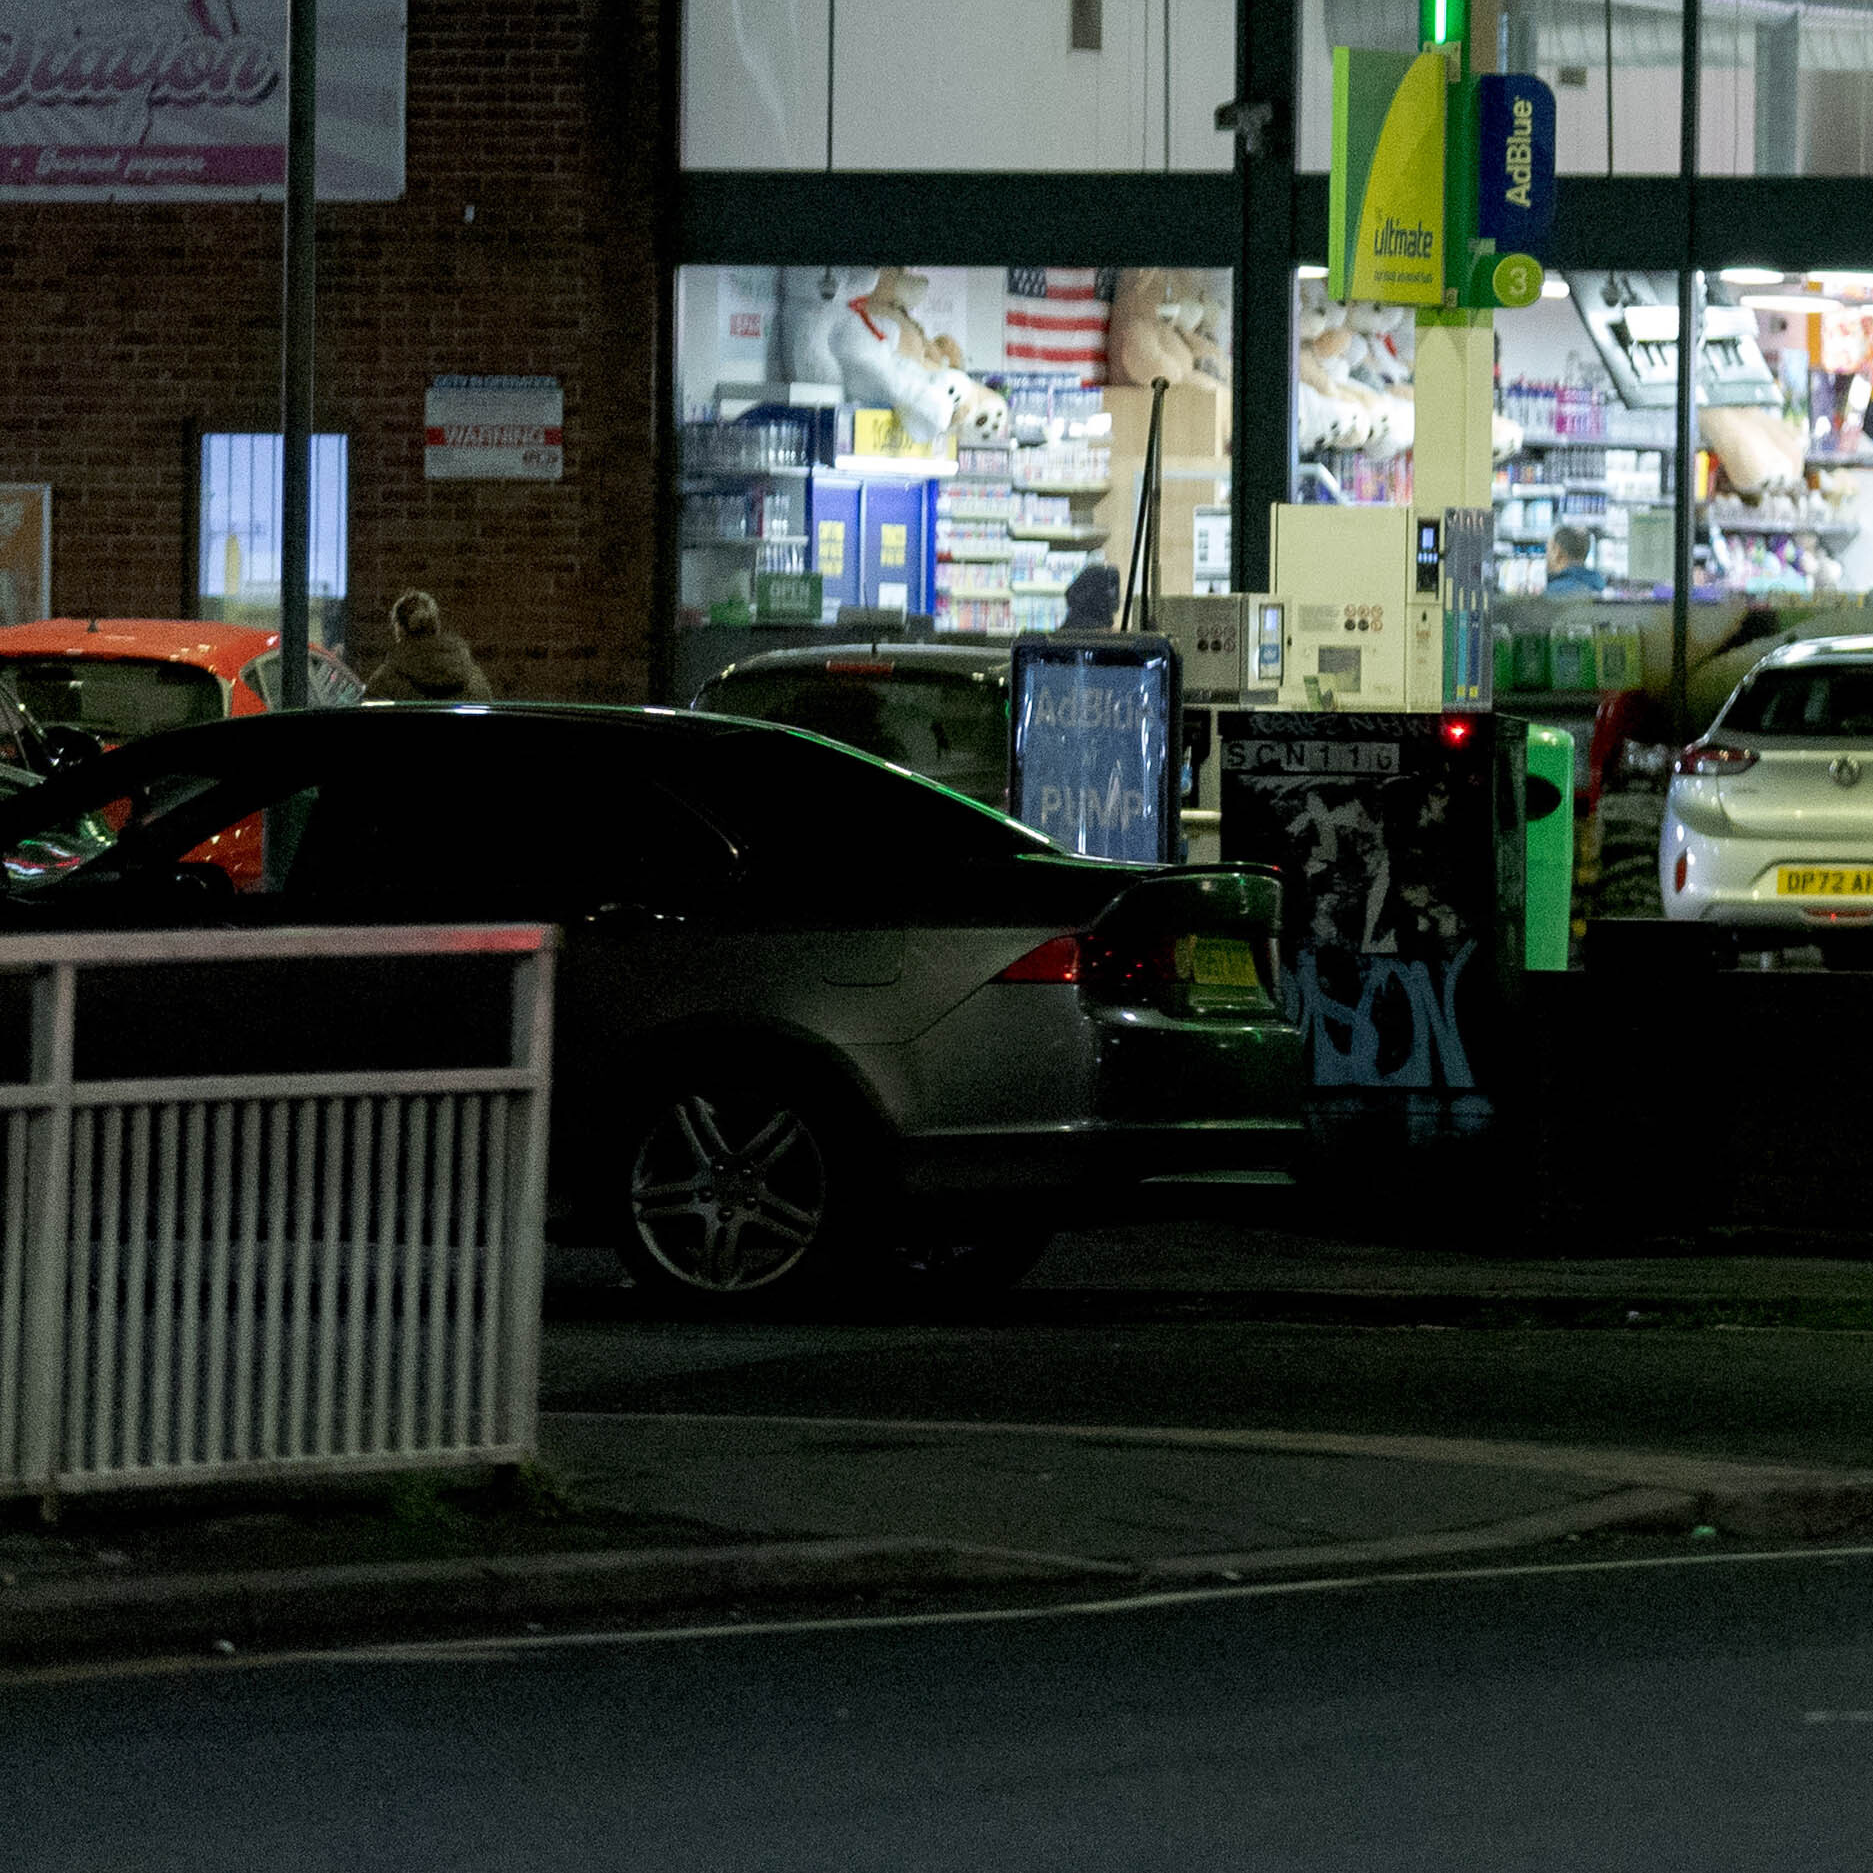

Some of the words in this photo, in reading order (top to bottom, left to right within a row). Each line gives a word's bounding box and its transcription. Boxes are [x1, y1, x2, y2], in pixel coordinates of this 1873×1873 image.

[1504, 95, 1535, 208] AdBlue
[1373, 217, 1434, 259] ultimate
[1509, 265, 1529, 296] 3
[1785, 869, 1844, 893] DP72
